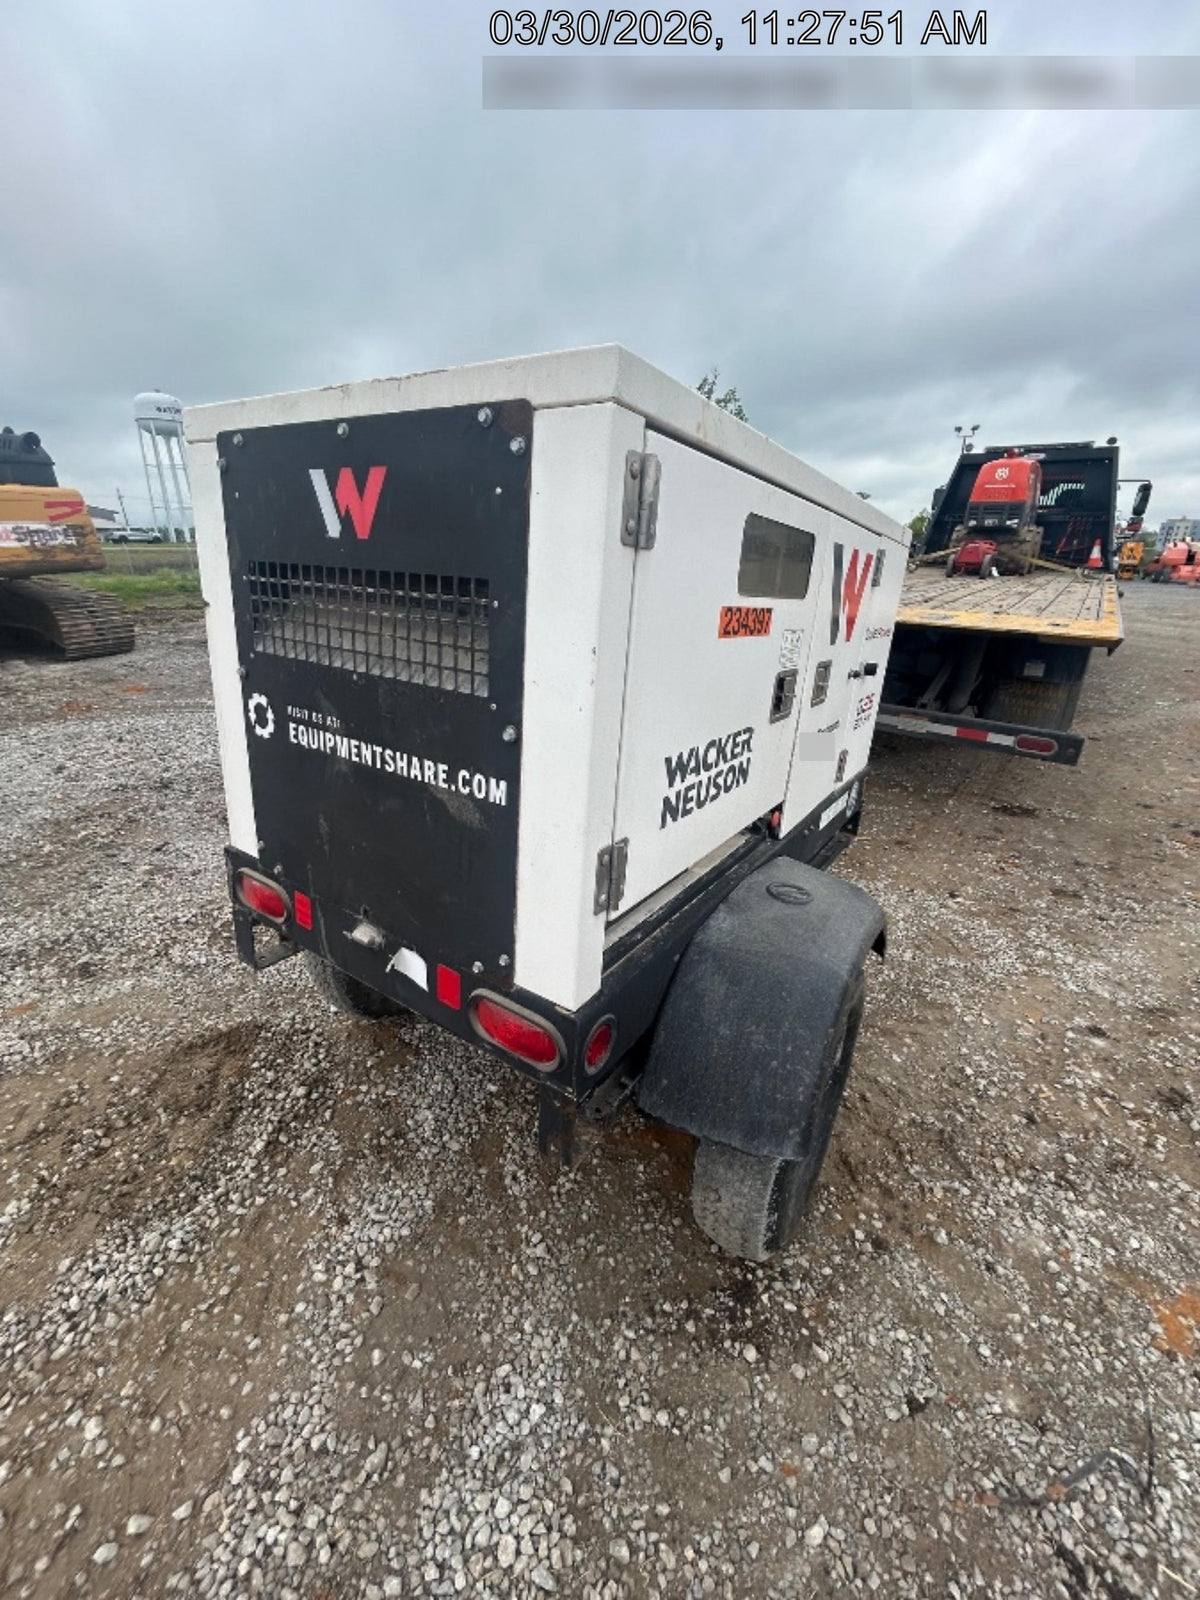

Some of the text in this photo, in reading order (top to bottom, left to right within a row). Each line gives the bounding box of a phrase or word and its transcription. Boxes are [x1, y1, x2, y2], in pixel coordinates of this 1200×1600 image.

[722, 606, 773, 637] 234397
[287, 705, 308, 720] VISIT
[312, 712, 323, 725] US
[289, 722, 507, 806] EQUIPMENTSHARE.COM
[664, 727, 755, 789] WACKER
[659, 757, 751, 829] NEUSON
